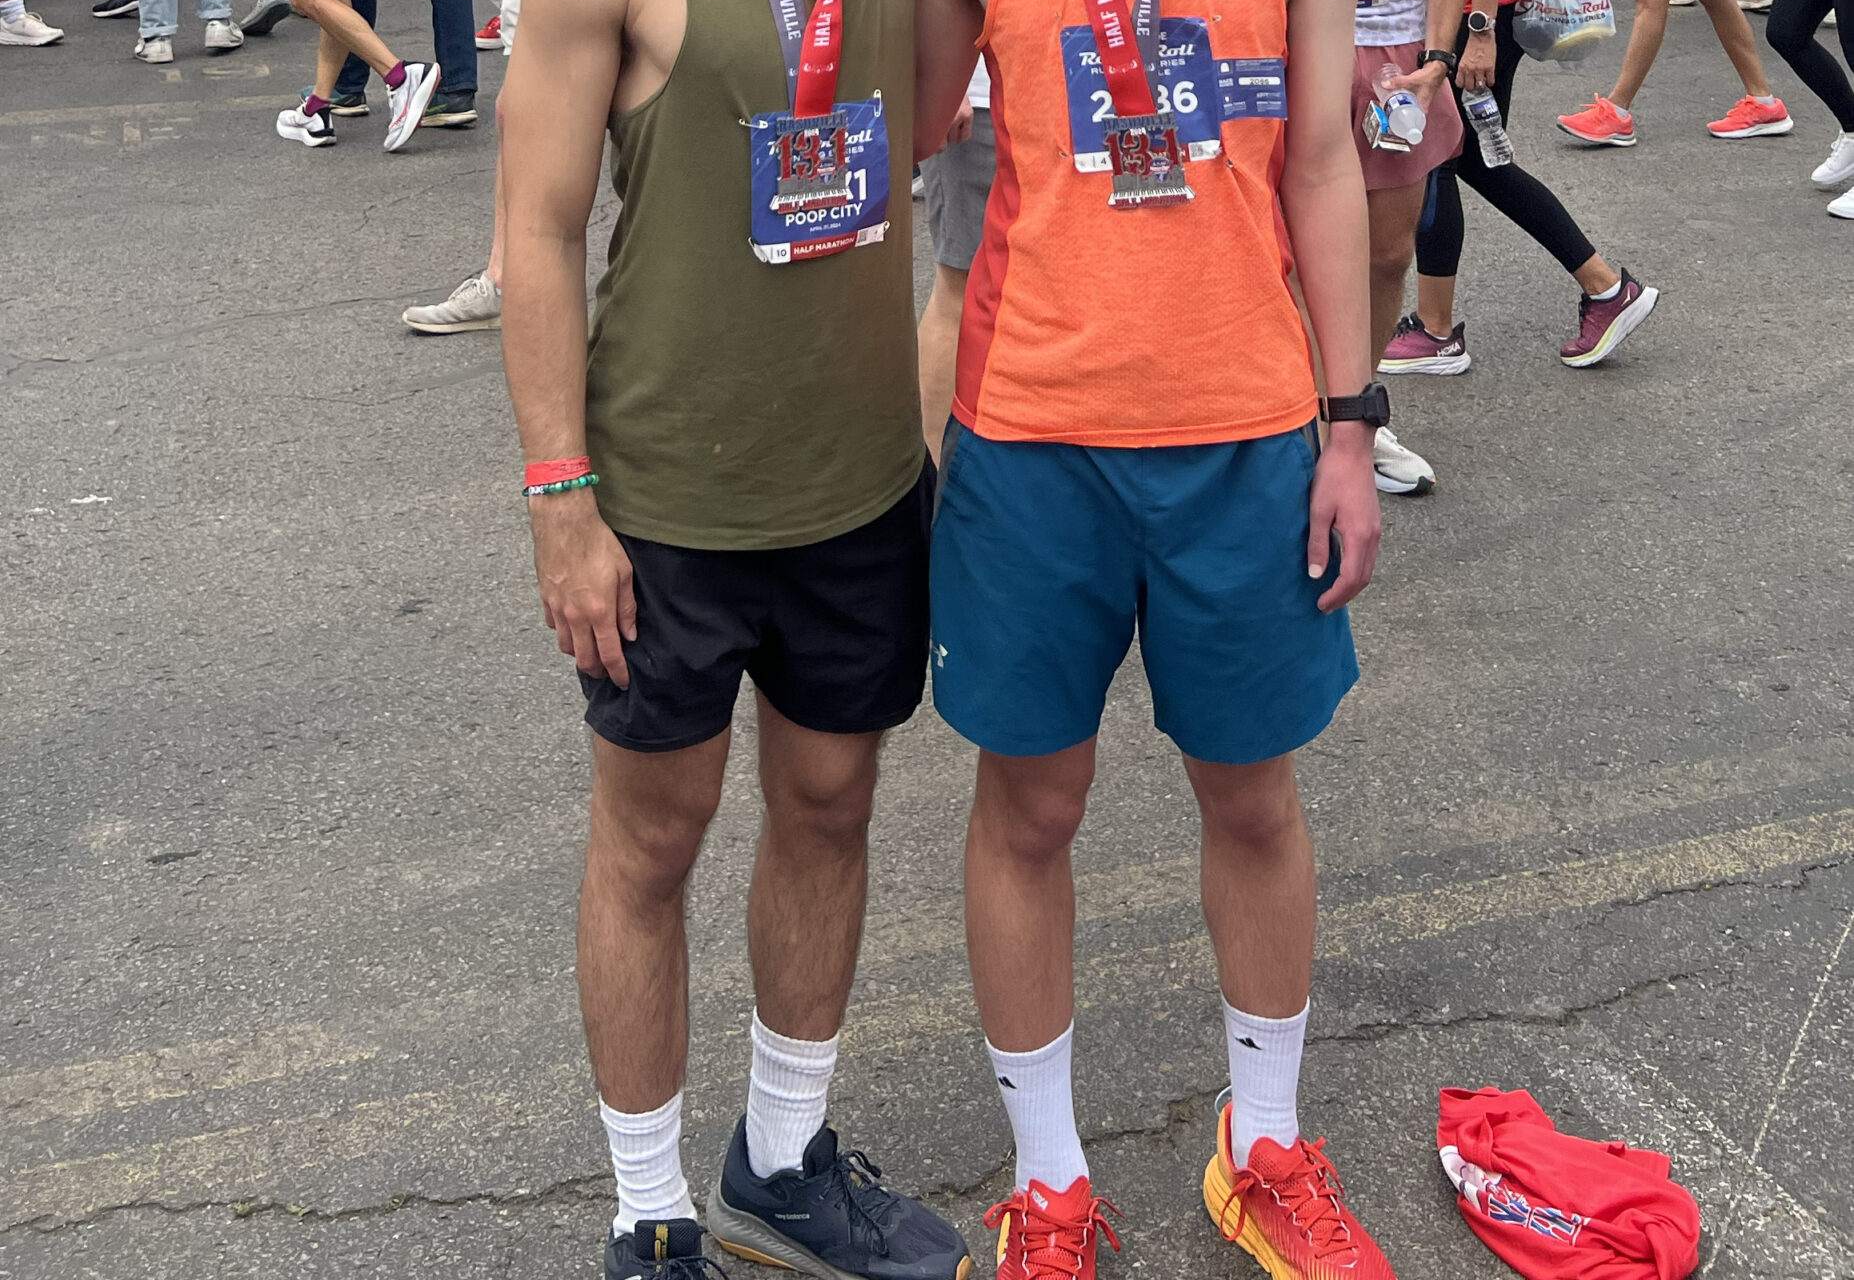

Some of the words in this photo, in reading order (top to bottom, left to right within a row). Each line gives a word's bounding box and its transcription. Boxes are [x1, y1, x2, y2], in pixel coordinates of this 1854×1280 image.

[1100, 9, 1125, 49] HALF
[785, 209, 827, 227] POOP
[830, 202, 863, 219] CITY
[776, 249, 787, 258] 10
[793, 245, 814, 255] HALF
[815, 236, 856, 252] MARATHON
[1437, 341, 1461, 357] HOKA
